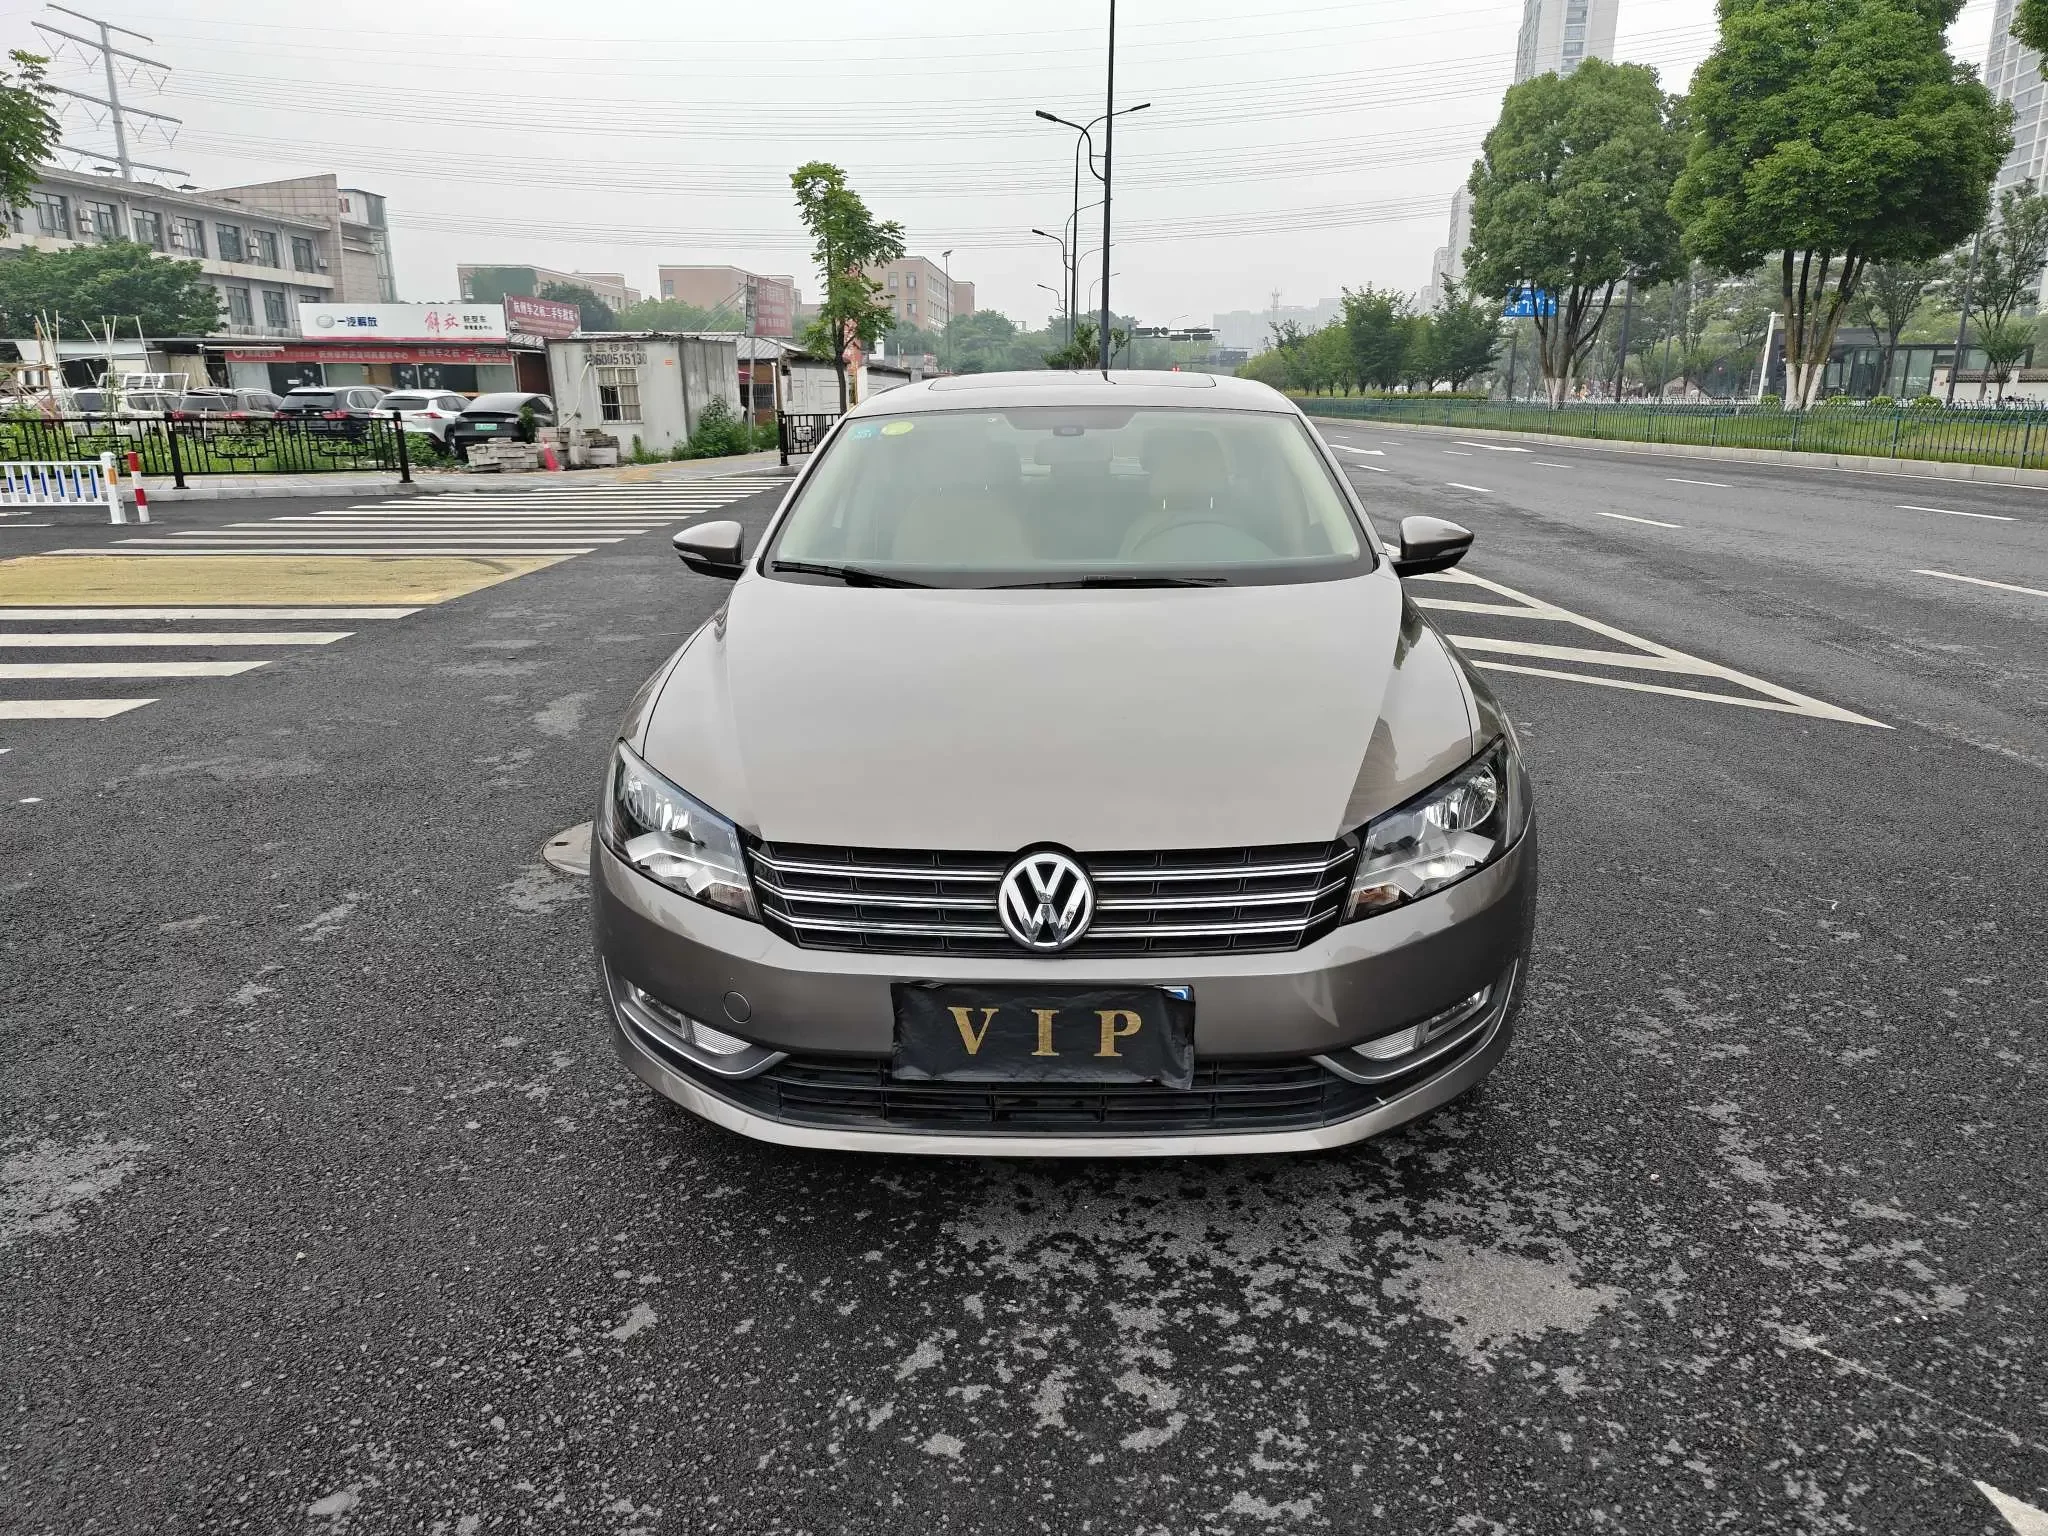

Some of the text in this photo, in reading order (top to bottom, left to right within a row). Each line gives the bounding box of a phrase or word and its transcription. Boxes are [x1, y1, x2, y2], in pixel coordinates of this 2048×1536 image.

[337, 316, 378, 327] 一汽解放
[947, 1006, 1142, 1057] VIP
